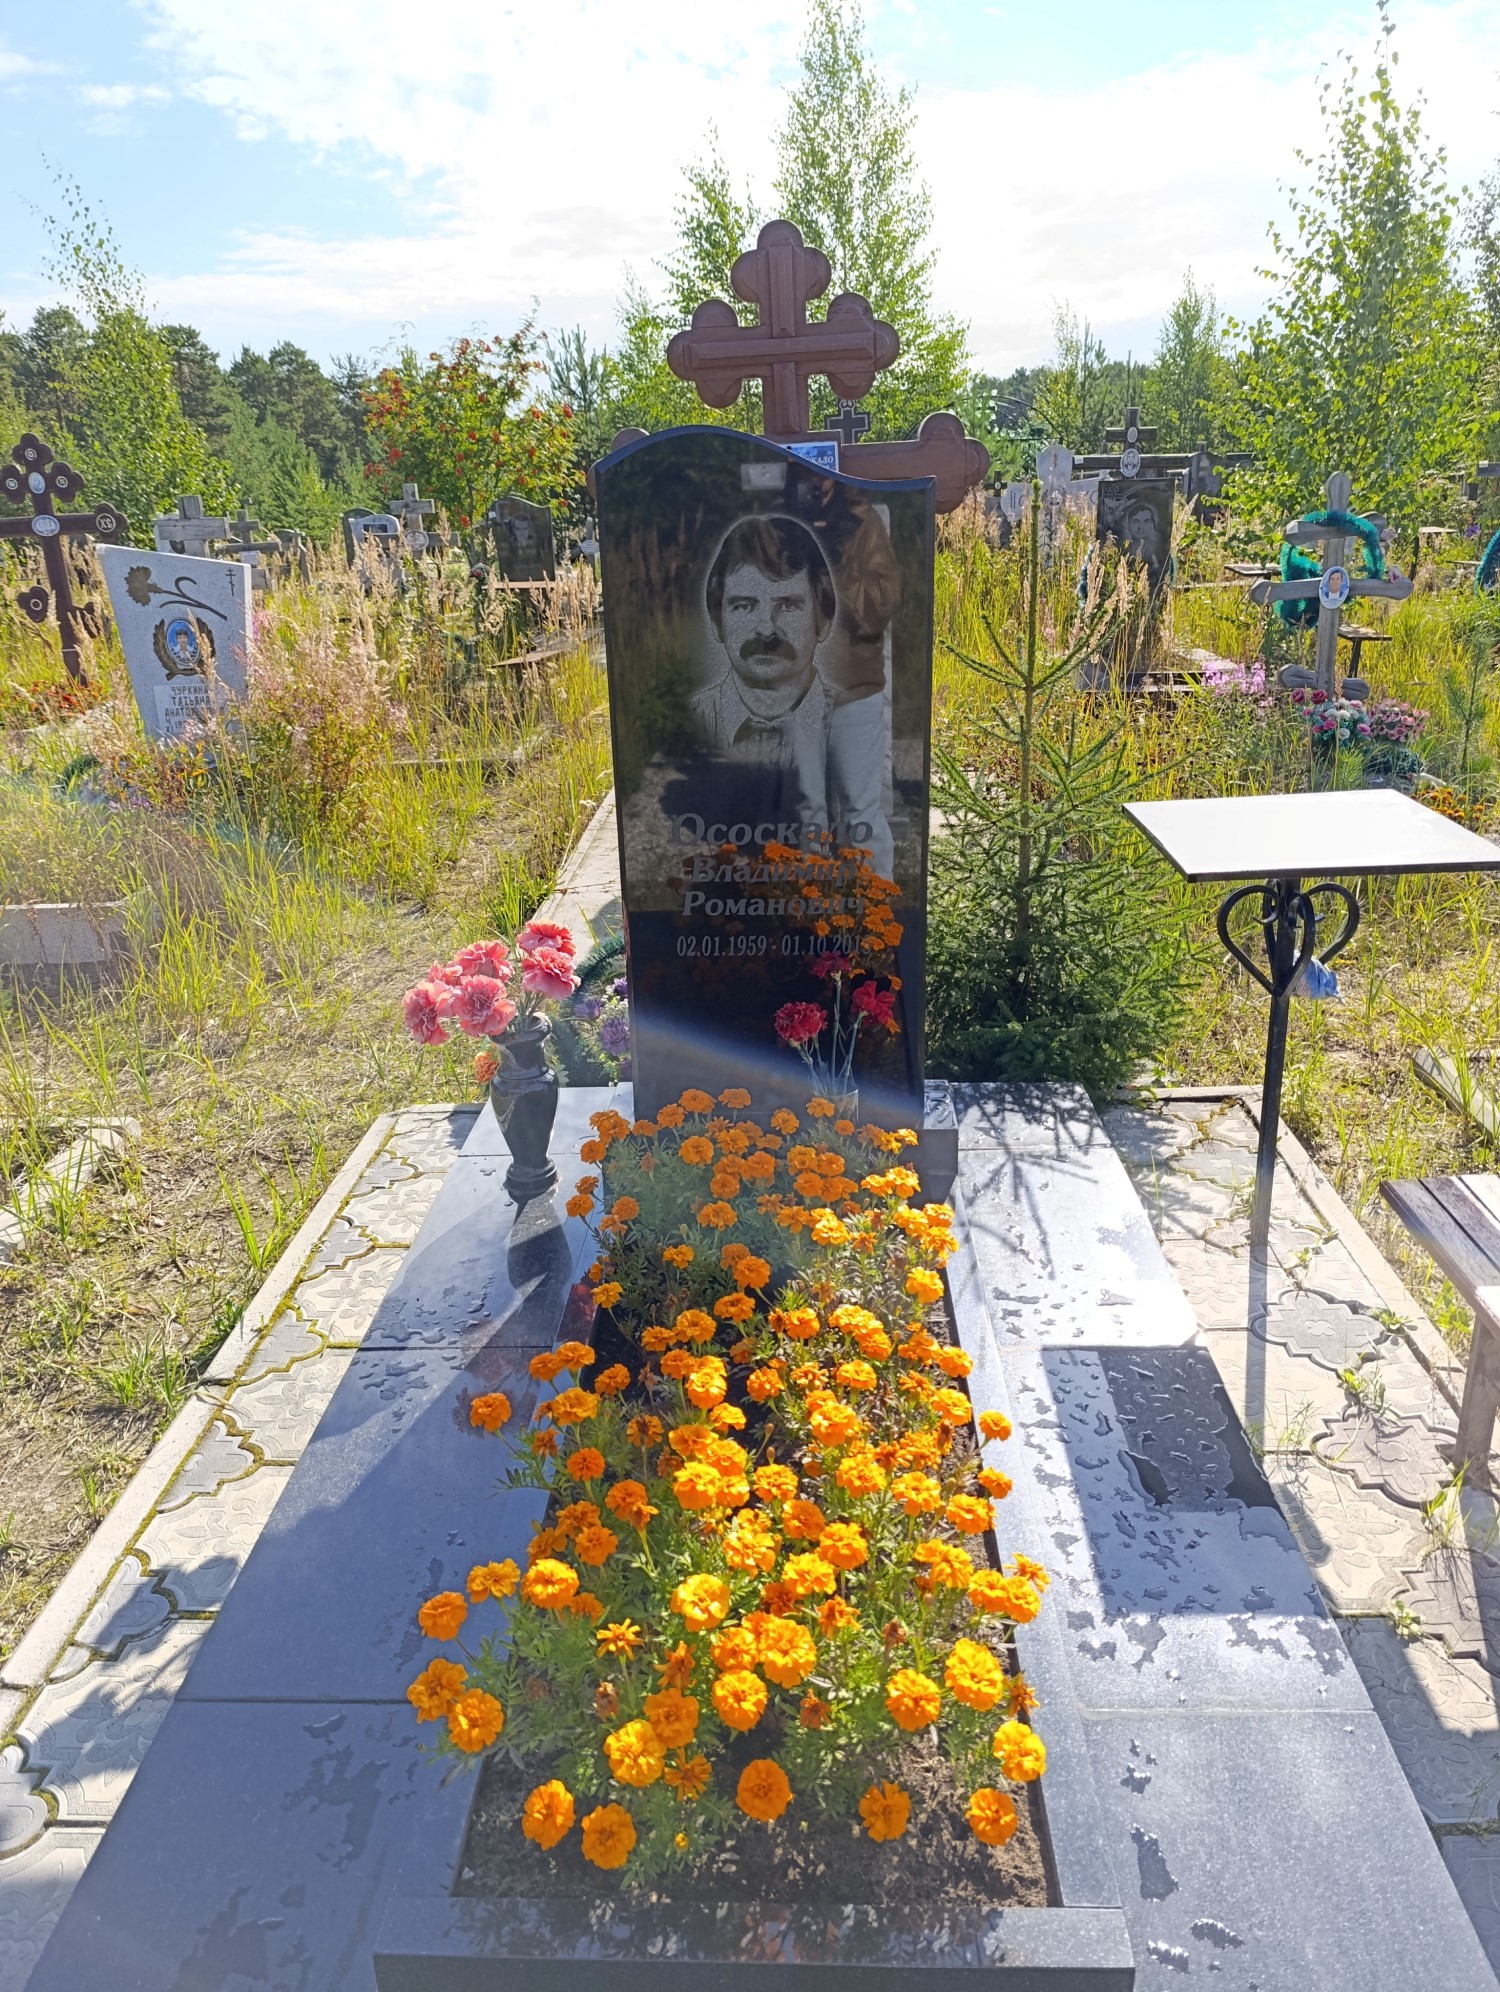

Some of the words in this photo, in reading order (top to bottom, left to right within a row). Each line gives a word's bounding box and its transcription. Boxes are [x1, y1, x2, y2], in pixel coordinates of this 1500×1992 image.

[171, 685, 209, 696] ЧУРКИНА
[171, 696, 211, 707] ТАТЬЯНА
[671, 813, 873, 846] Ососкало
[691, 854, 855, 887] Владимир
[682, 890, 865, 916] Романович
[676, 935, 767, 957] 02.01.1959
[781, 934, 872, 956] 01.10201
